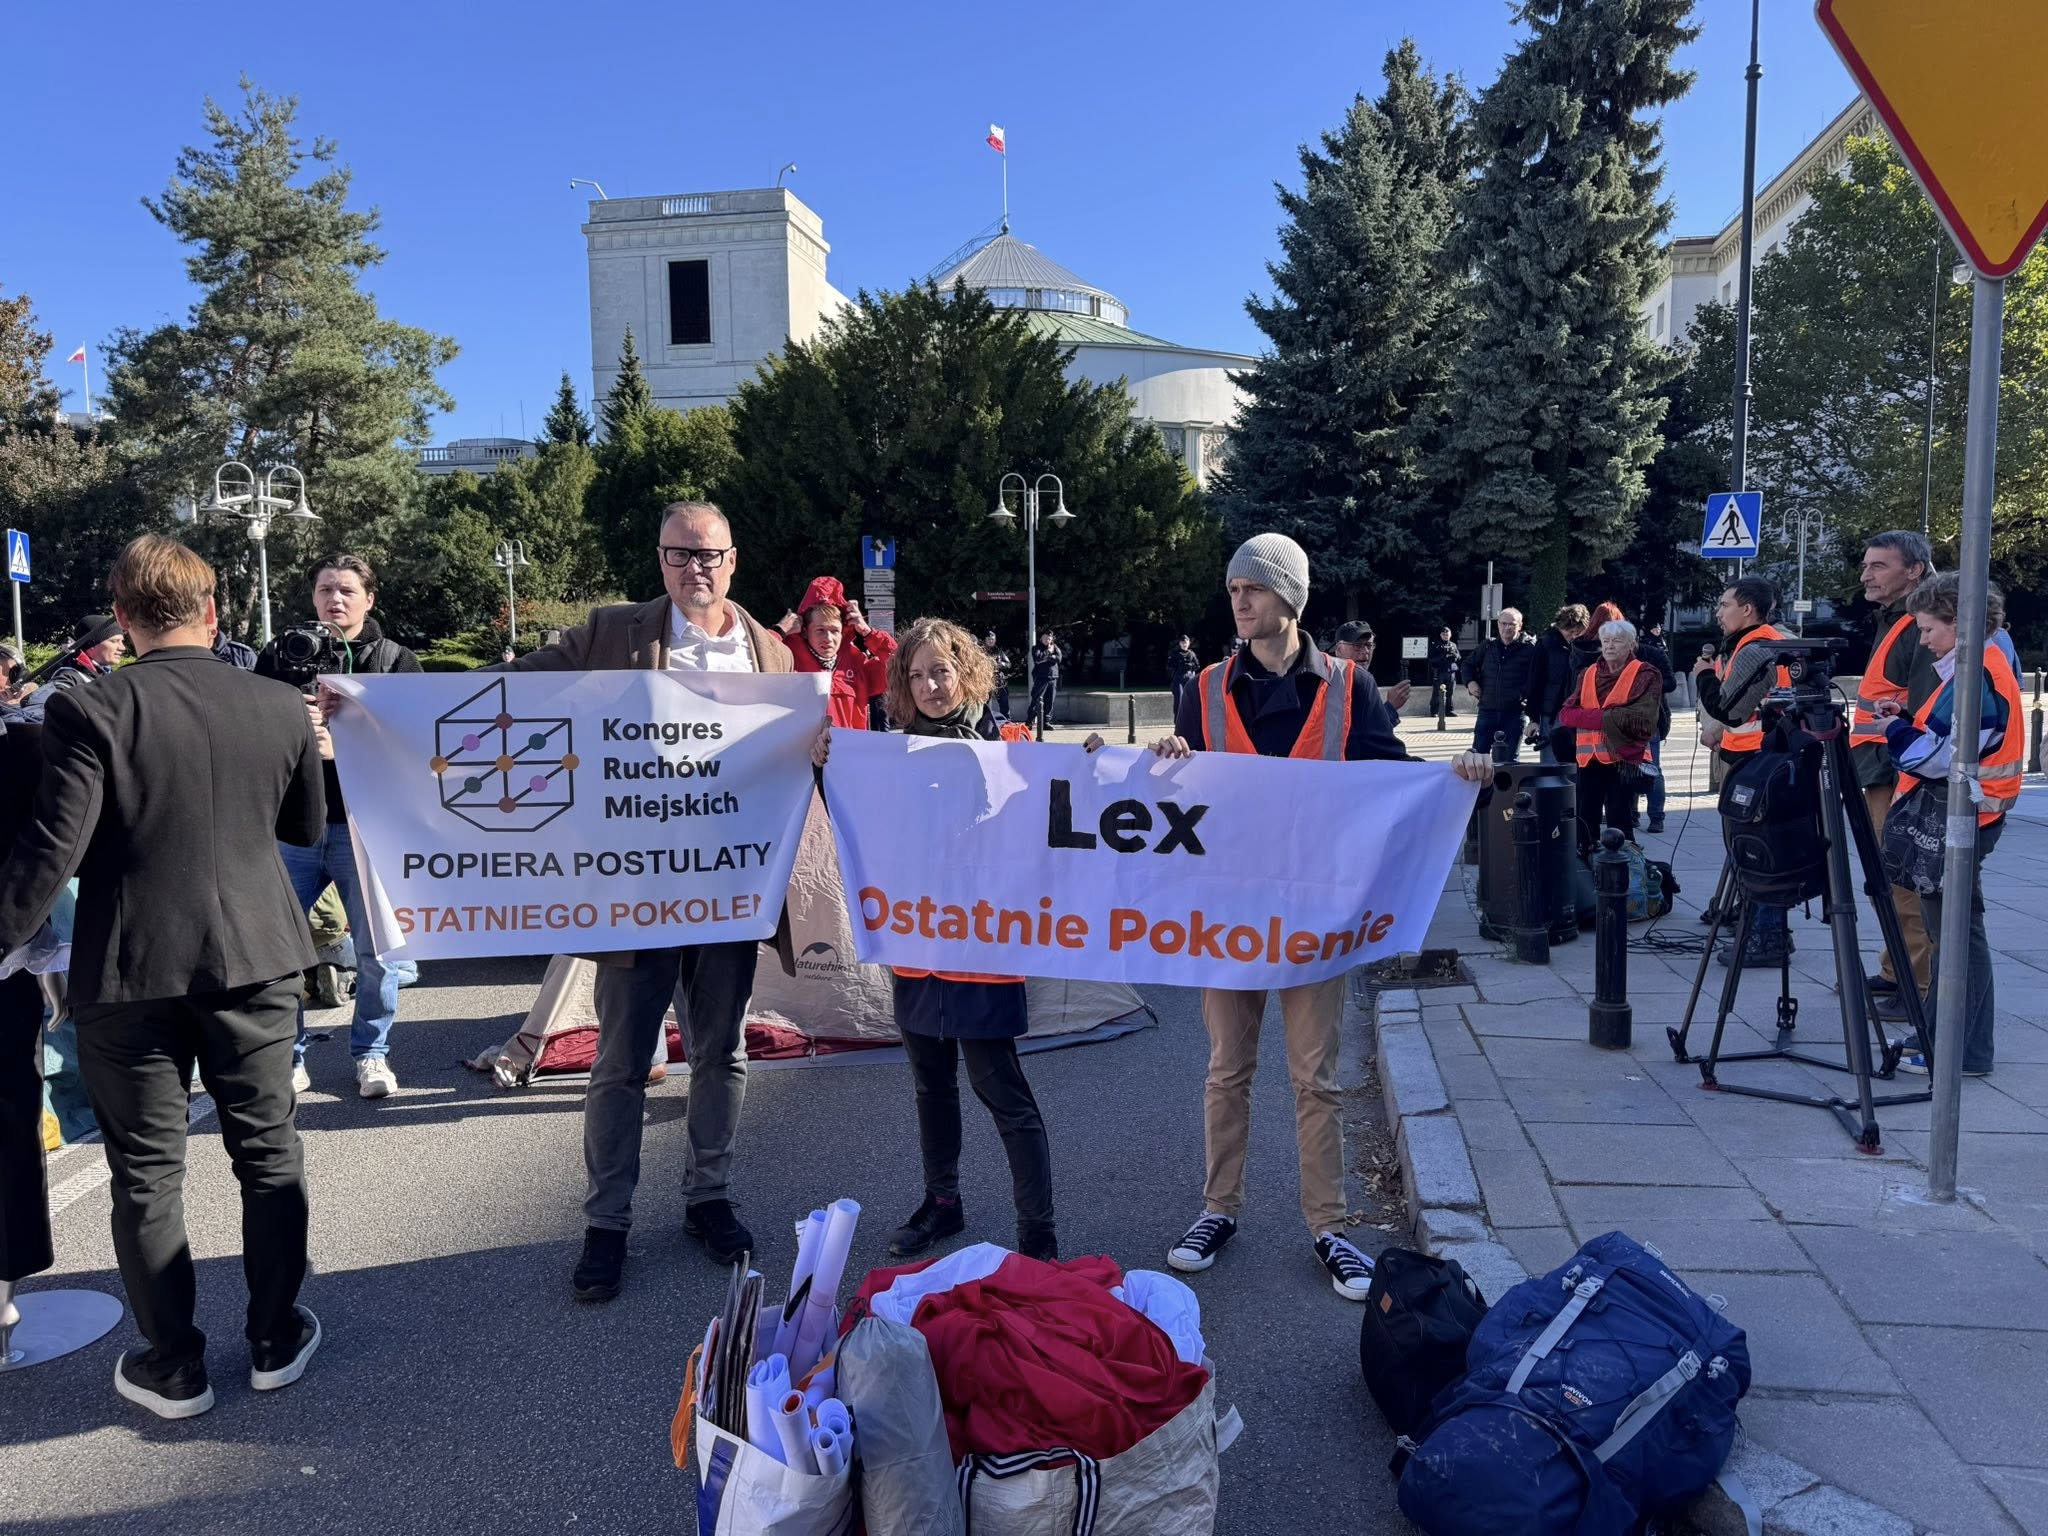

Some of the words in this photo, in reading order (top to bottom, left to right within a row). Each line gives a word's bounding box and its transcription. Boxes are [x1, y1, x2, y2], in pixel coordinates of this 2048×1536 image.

[602, 717, 723, 746] Kongres
[603, 755, 721, 781] Ruchów
[604, 791, 739, 823] Miejskich
[1047, 778, 1211, 856] Lex
[403, 852, 564, 879] POPIERA
[573, 841, 772, 877] POSTULATY
[857, 885, 1089, 949] Ostatnie
[1109, 907, 1395, 966] Pokolenie
